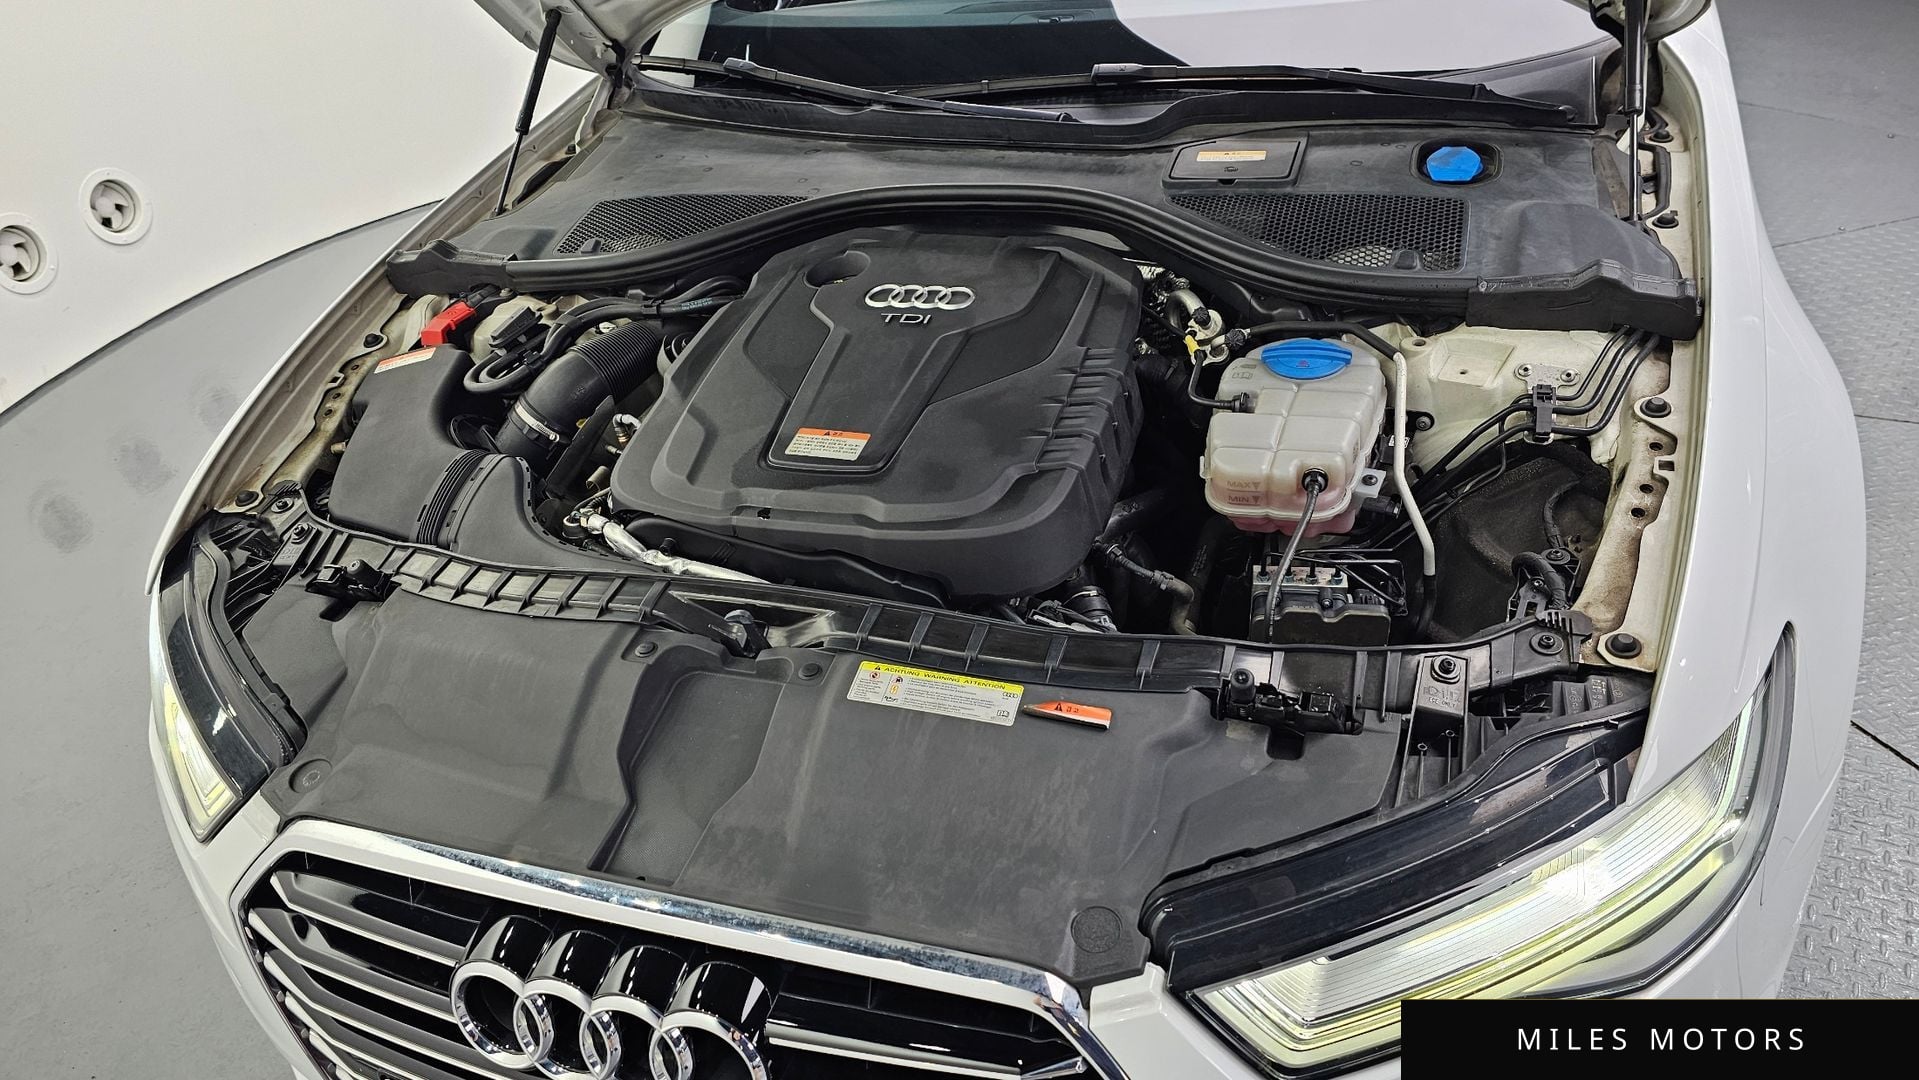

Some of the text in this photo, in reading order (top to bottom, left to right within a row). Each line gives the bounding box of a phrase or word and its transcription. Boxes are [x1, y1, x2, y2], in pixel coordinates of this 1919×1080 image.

[881, 313, 932, 324] TDI
[1227, 480, 1251, 488] MAX
[1228, 495, 1249, 503] MIN
[884, 667, 1006, 690] ACHTUNG WARNING ATTENTION
